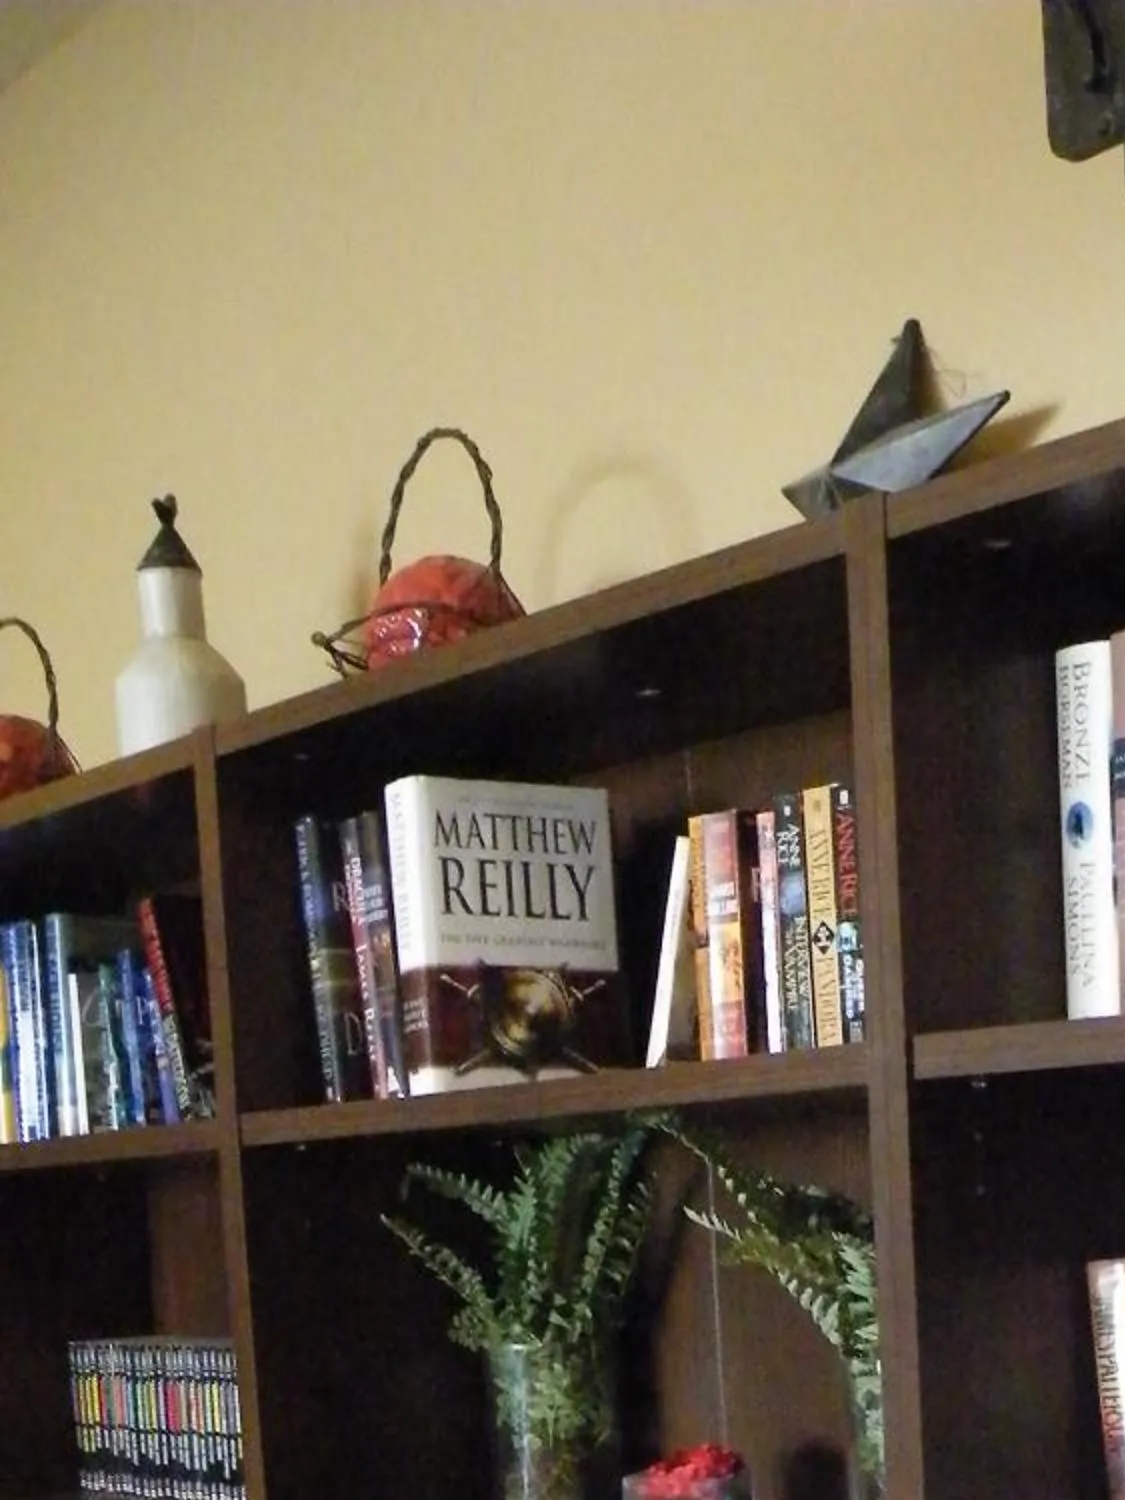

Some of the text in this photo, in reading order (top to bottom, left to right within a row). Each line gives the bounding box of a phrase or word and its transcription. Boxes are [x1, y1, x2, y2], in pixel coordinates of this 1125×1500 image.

[1072, 661, 1093, 782] BRONZE
[434, 810, 597, 855] MATTHEW
[836, 812, 859, 917] ANNE RICE
[438, 856, 595, 922] REILLY
[1067, 876, 1081, 976] SIMONS
